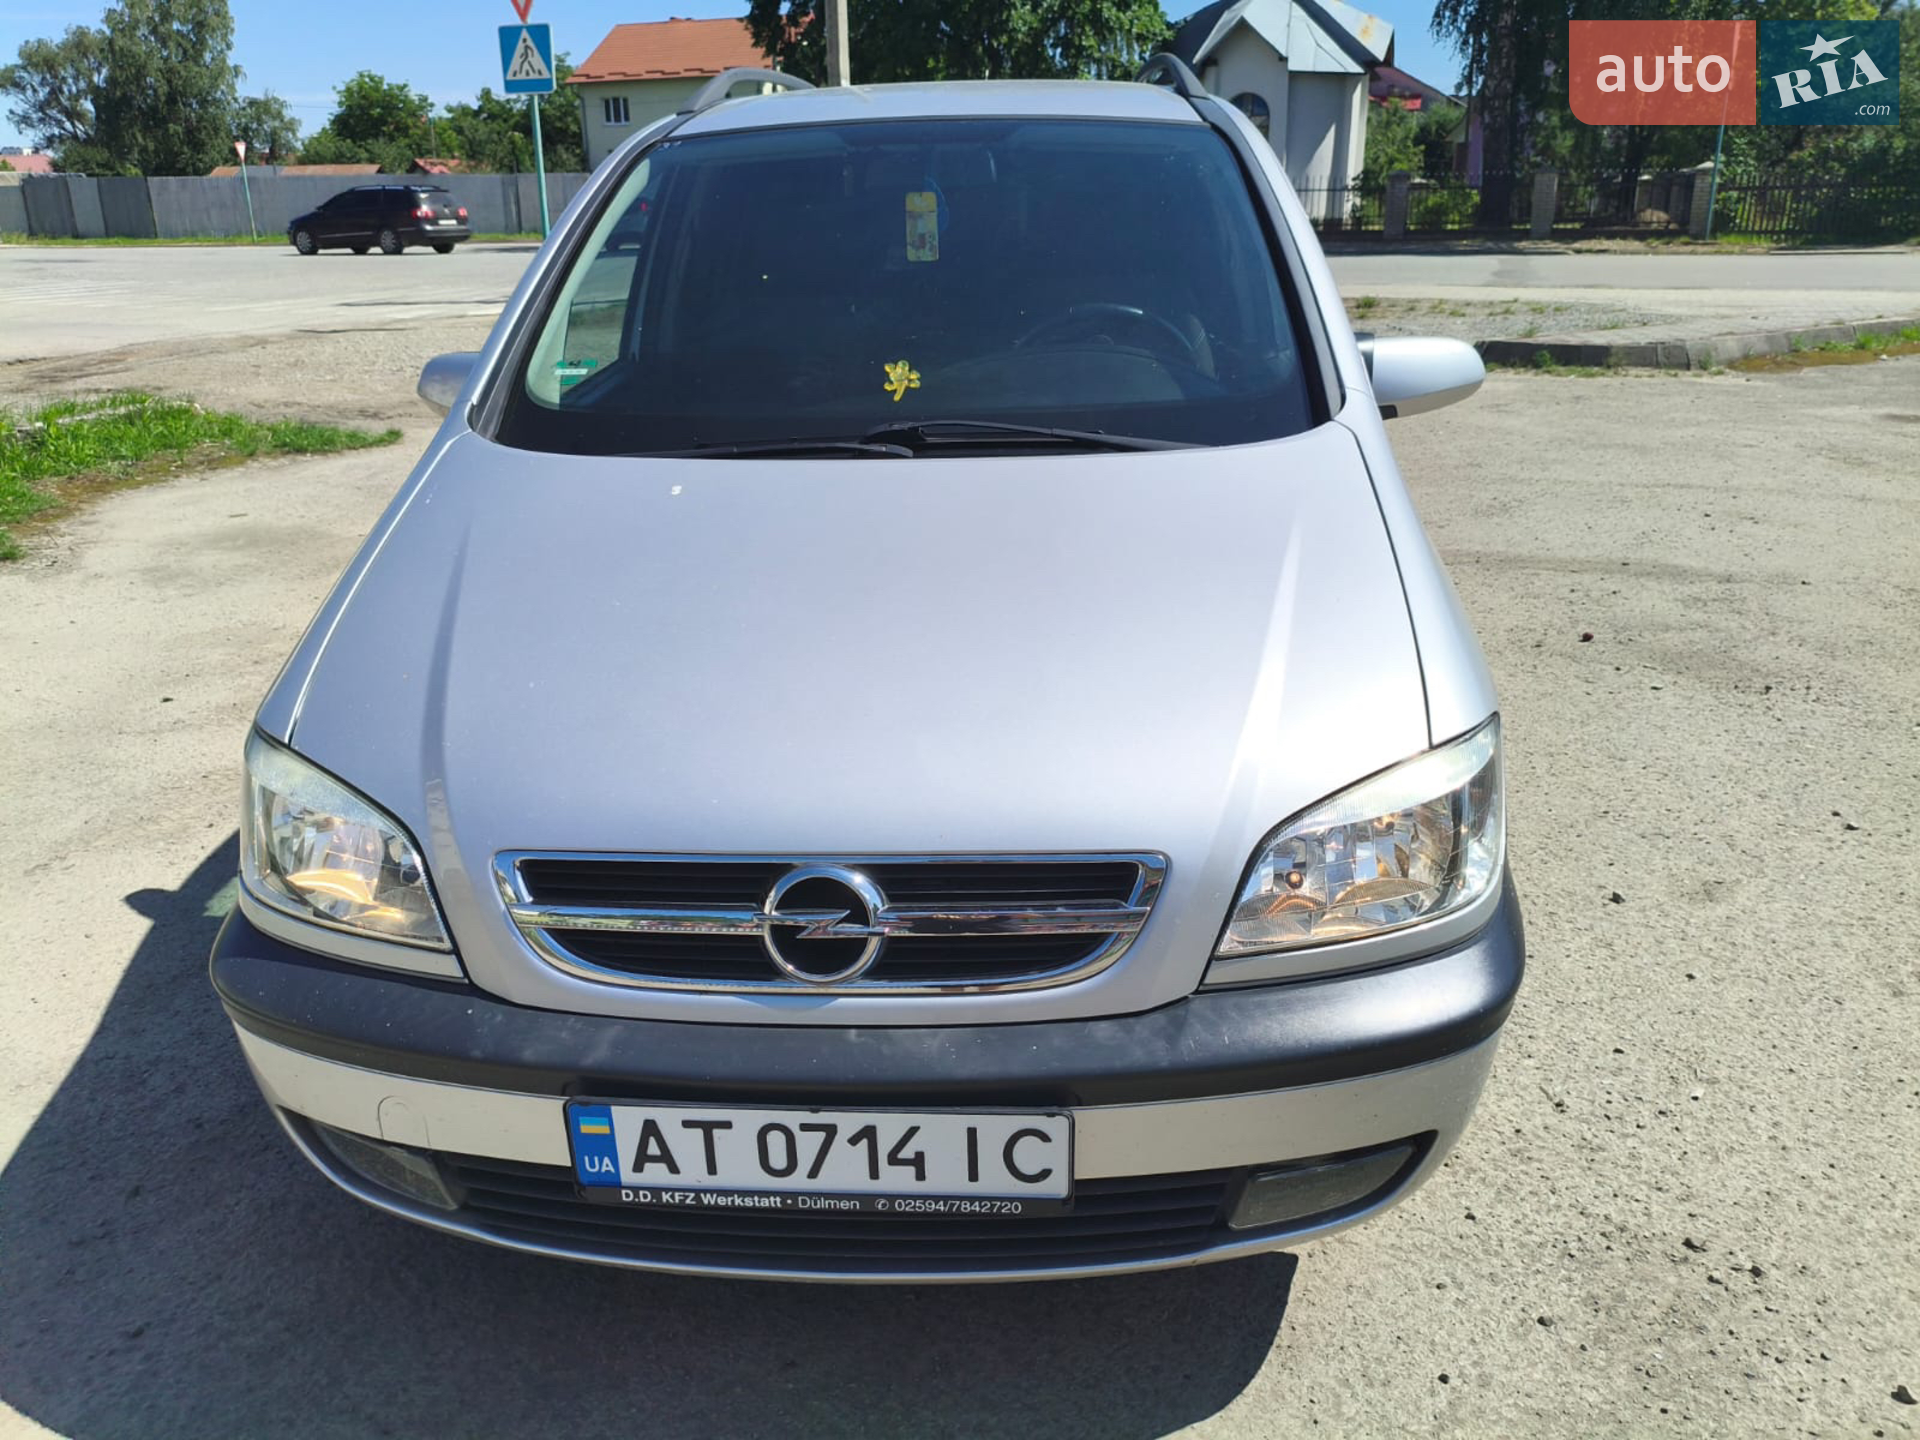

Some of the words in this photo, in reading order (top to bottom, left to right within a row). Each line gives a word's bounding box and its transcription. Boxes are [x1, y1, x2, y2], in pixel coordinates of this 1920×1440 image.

[631, 1118, 733, 1176] AT
[757, 1122, 926, 1182] 0714
[966, 1125, 1053, 1184] IC
[584, 1155, 615, 1173] UA
[621, 1189, 656, 1202] D.D.
[661, 1191, 696, 1204] KFZ
[701, 1193, 782, 1208] Werkstatt
[798, 1196, 860, 1210] Dülmen
[894, 1198, 1022, 1214] 02594/7842720
